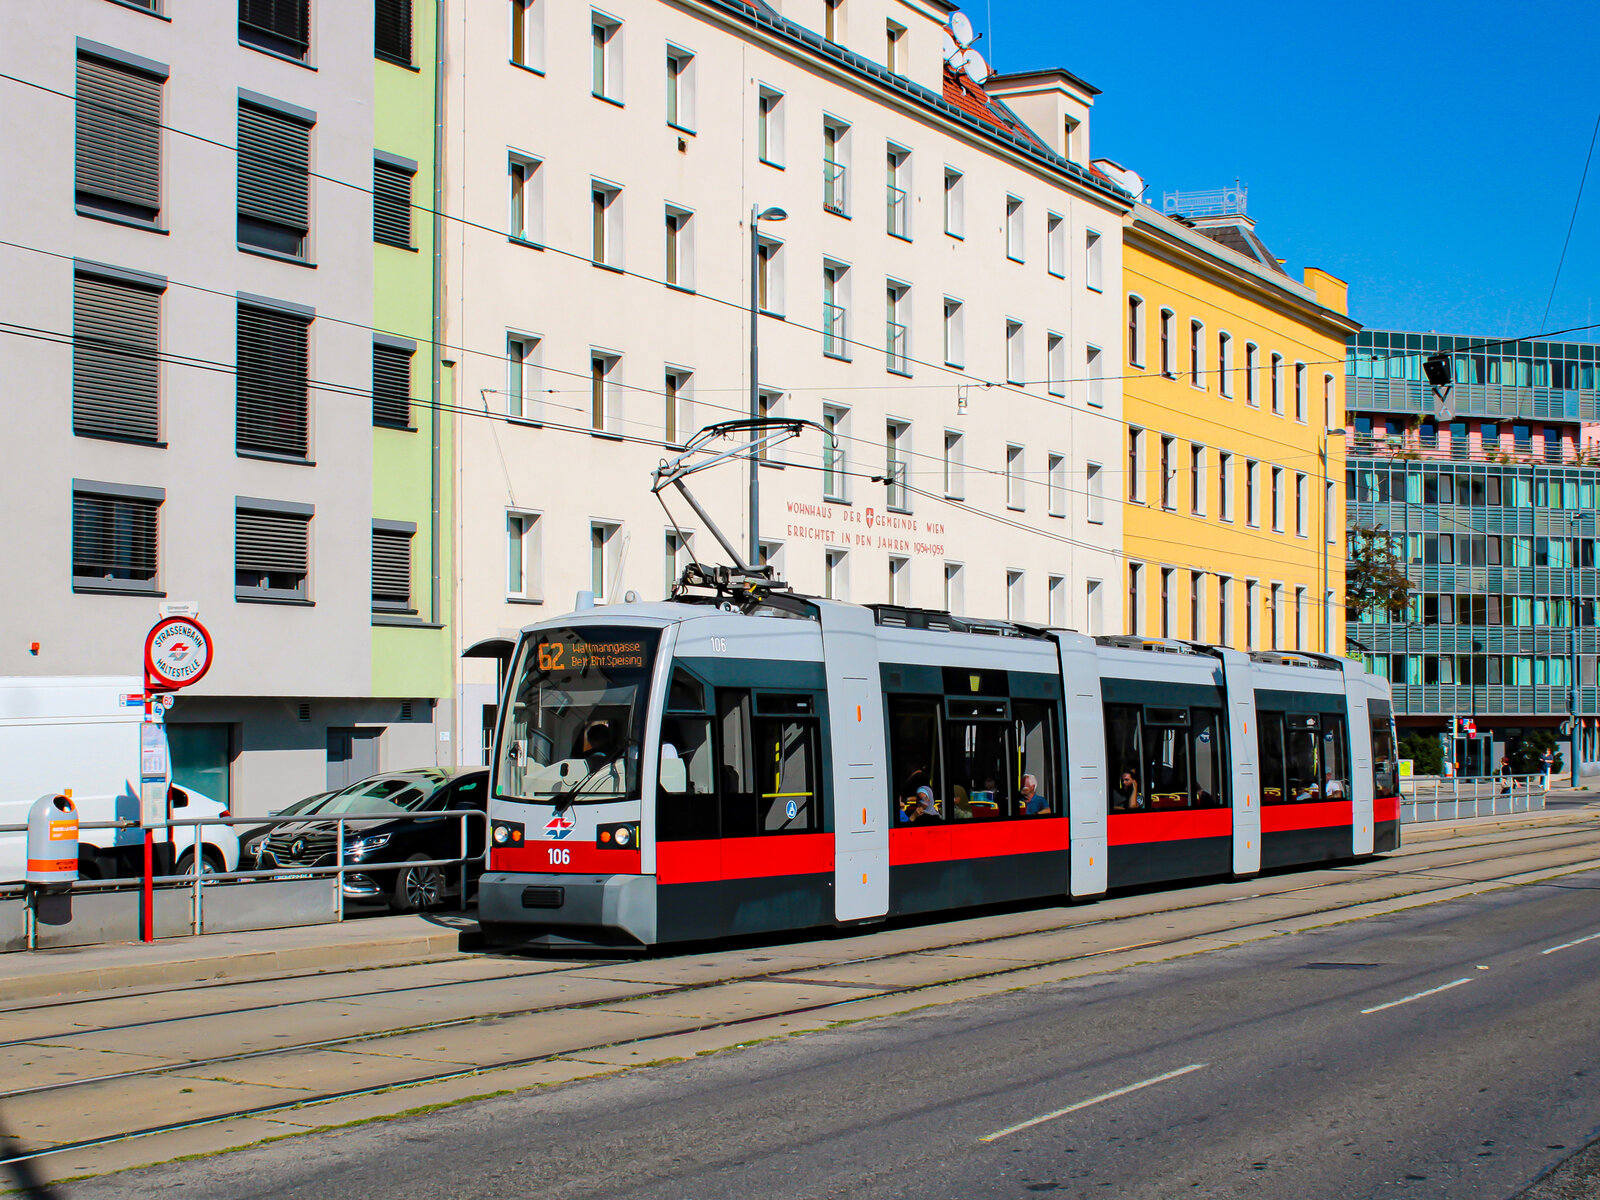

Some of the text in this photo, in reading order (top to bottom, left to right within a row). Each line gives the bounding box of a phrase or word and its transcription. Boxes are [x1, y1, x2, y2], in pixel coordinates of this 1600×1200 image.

[786, 501, 945, 534] WOHNHAUS DER GEMEINDE WIEN
[787, 524, 836, 542] ERRICHTET
[841, 532, 851, 544] IN
[855, 535, 872, 547] DEN
[877, 535, 910, 551] JAHREN
[154, 625, 204, 648] STRASSENBAHN
[710, 636, 727, 652] 106
[538, 642, 565, 671] 62
[156, 658, 201, 678] HALTESTELLE
[163, 696, 173, 706] 62
[547, 848, 571, 865] 106
